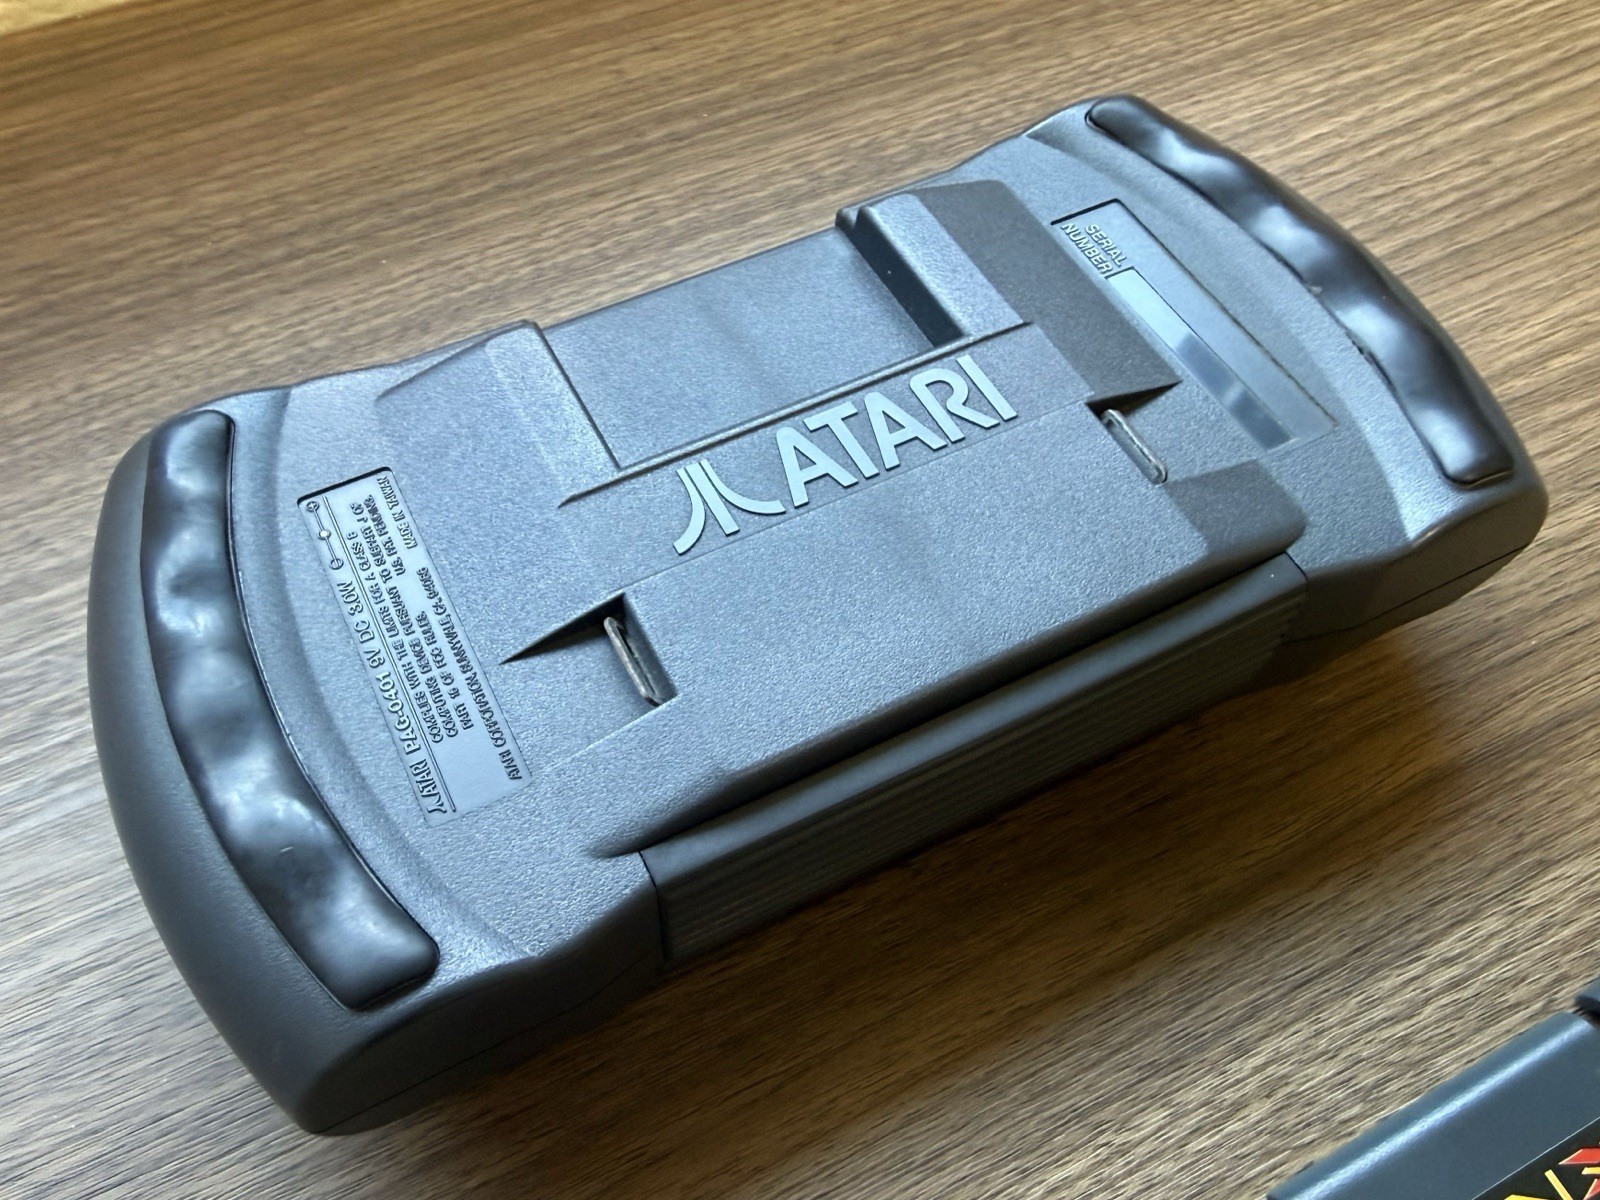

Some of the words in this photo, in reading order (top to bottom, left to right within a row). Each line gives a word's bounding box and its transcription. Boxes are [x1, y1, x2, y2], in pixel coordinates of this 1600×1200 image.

[1060, 222, 1113, 276] NUMBER
[1084, 223, 1128, 267] SERIAL
[775, 354, 1018, 508] ATARI
[376, 476, 399, 509] TAIWAN
[350, 501, 364, 515] OF
[392, 510, 405, 521] IN
[360, 525, 386, 566] SUBPART
[396, 522, 418, 549] MADE
[350, 541, 371, 571] CLASS
[364, 572, 375, 581] A
[378, 568, 393, 583] TO
[368, 583, 384, 604] FOR
[377, 605, 399, 638] LIMITS
[385, 585, 415, 635] PURSUANT
[353, 618, 375, 643] DC
[364, 645, 385, 669] 9V
[391, 639, 408, 660] THE
[407, 637, 432, 674] DEVICE
[429, 646, 447, 668] FCC
[401, 661, 421, 689] WITH
[439, 669, 454, 686] OF
[374, 670, 421, 755] PAG-0401
[413, 690, 444, 743] COMPLIES
[423, 676, 459, 738] COMPUTING
[453, 702, 473, 730] PART
[410, 758, 439, 800] ATARI
[498, 749, 521, 782] ATARI
